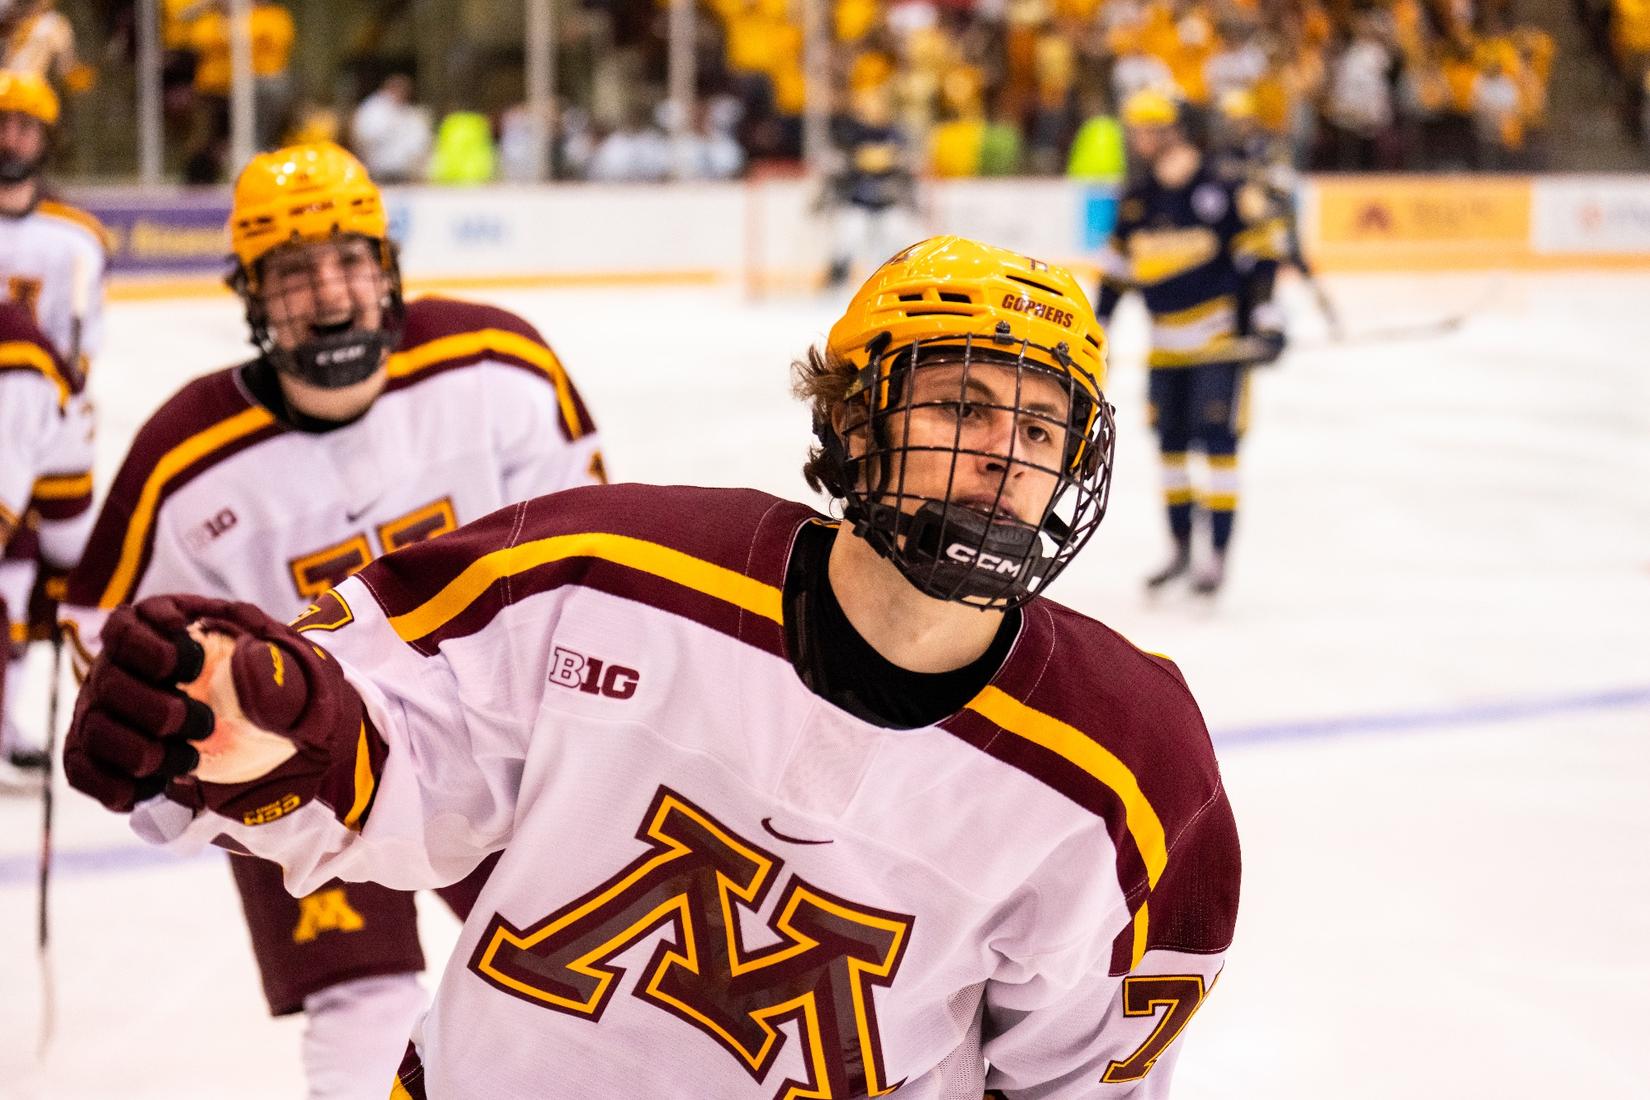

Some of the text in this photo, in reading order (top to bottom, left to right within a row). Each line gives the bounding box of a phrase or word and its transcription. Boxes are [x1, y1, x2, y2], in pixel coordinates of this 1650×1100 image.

[1001, 293, 1074, 329] GOPHERS
[945, 542, 1022, 578] CCM
[1099, 974, 1208, 1083] 7
